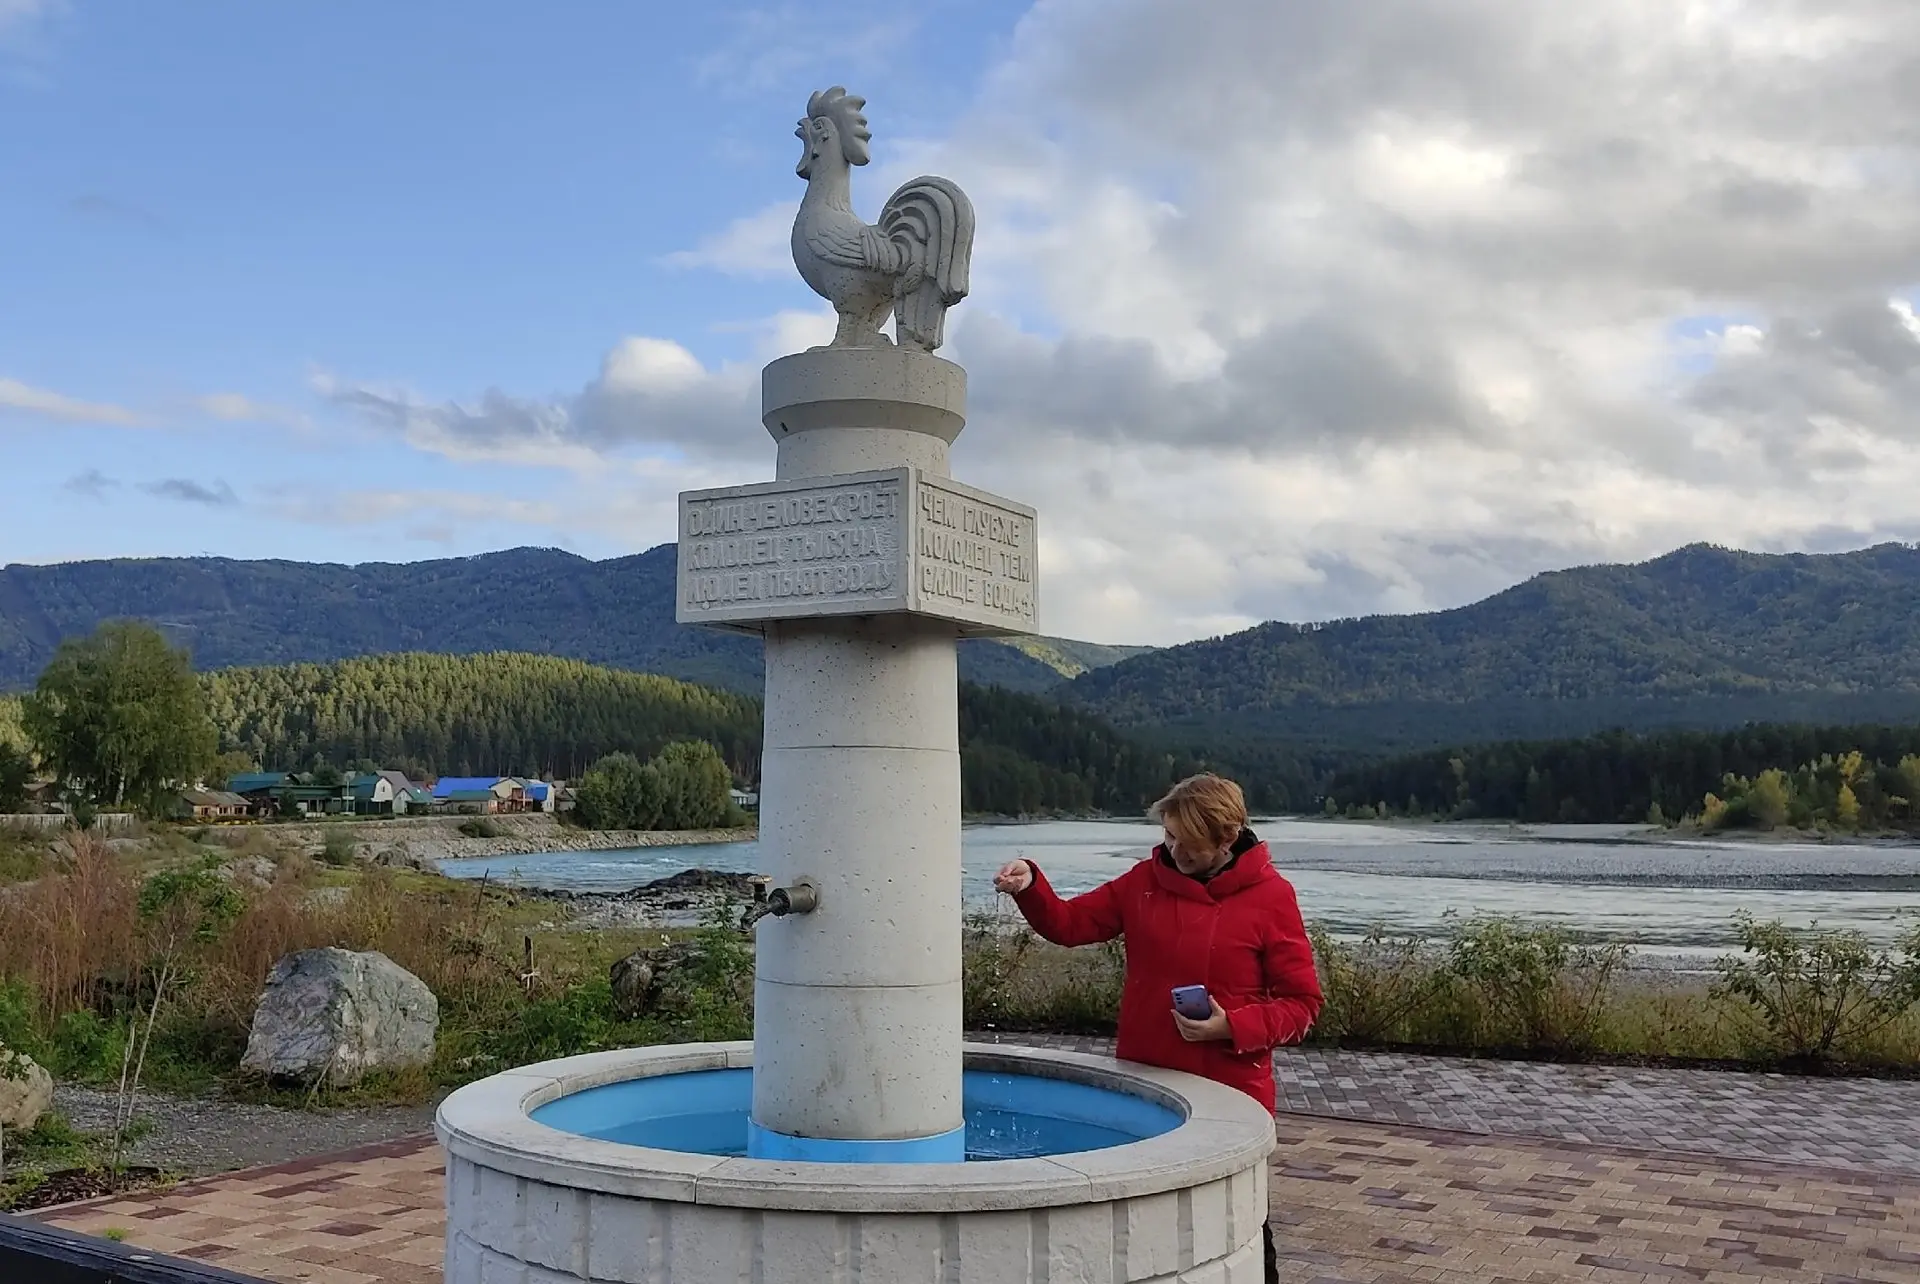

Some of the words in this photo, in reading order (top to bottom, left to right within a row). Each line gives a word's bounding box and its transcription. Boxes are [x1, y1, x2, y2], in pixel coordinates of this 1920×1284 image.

[687, 503, 745, 536] ОДИН
[749, 493, 844, 533] ЧЕЛОВЕК
[843, 488, 899, 521] РОЕТ
[921, 491, 956, 530] ЧЕМ
[963, 506, 1019, 548] ГЛУБЖЕ
[1000, 552, 1030, 583] ТЕМ
